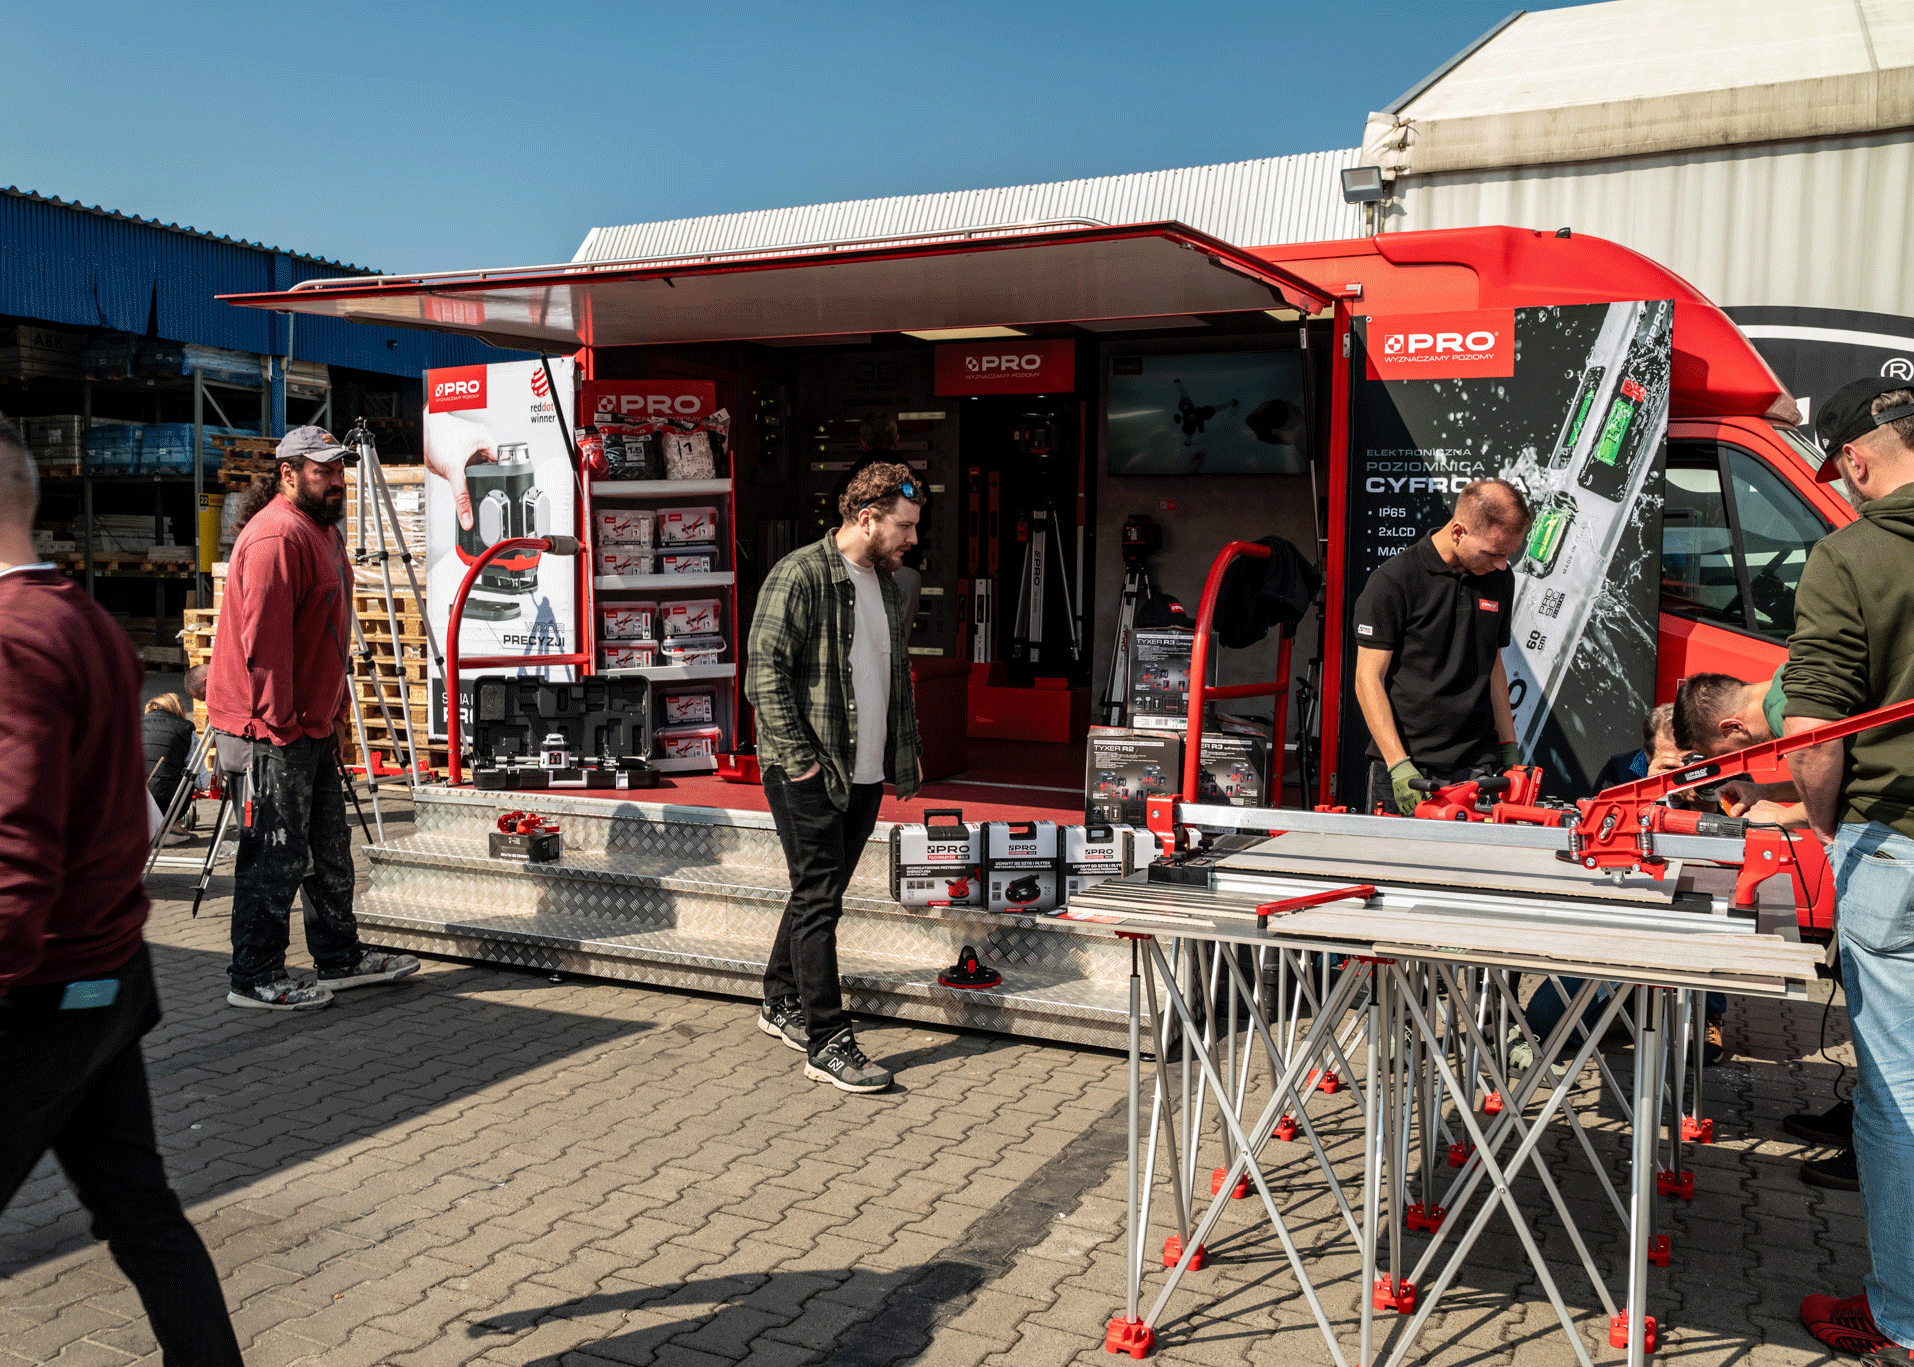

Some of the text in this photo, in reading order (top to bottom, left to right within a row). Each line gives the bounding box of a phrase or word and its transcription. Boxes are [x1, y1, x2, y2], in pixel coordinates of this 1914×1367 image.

[1408, 331, 1495, 353] PRO
[981, 354, 1041, 372] PRO
[1384, 353, 1495, 363] WYZNACZAMY POZIOMY
[444, 380, 480, 396] PRO
[620, 394, 701, 414] PRO
[530, 414, 556, 424] winner
[1366, 448, 1472, 457] ELEKTRONICZNA
[1366, 461, 1485, 472] POZIOMNICA
[1365, 477, 1529, 494] CYFROA
[1379, 507, 1406, 518] IP65
[1378, 527, 1416, 537] 2xLCD
[1538, 588, 1553, 615] PRO
[1545, 591, 1560, 617] 900
[503, 635, 565, 647] PRECYZJI
[1526, 630, 1541, 650] 60
[1537, 635, 1547, 651] cm
[1094, 744, 1121, 752] TYXER
[936, 845, 970, 853] PRO
